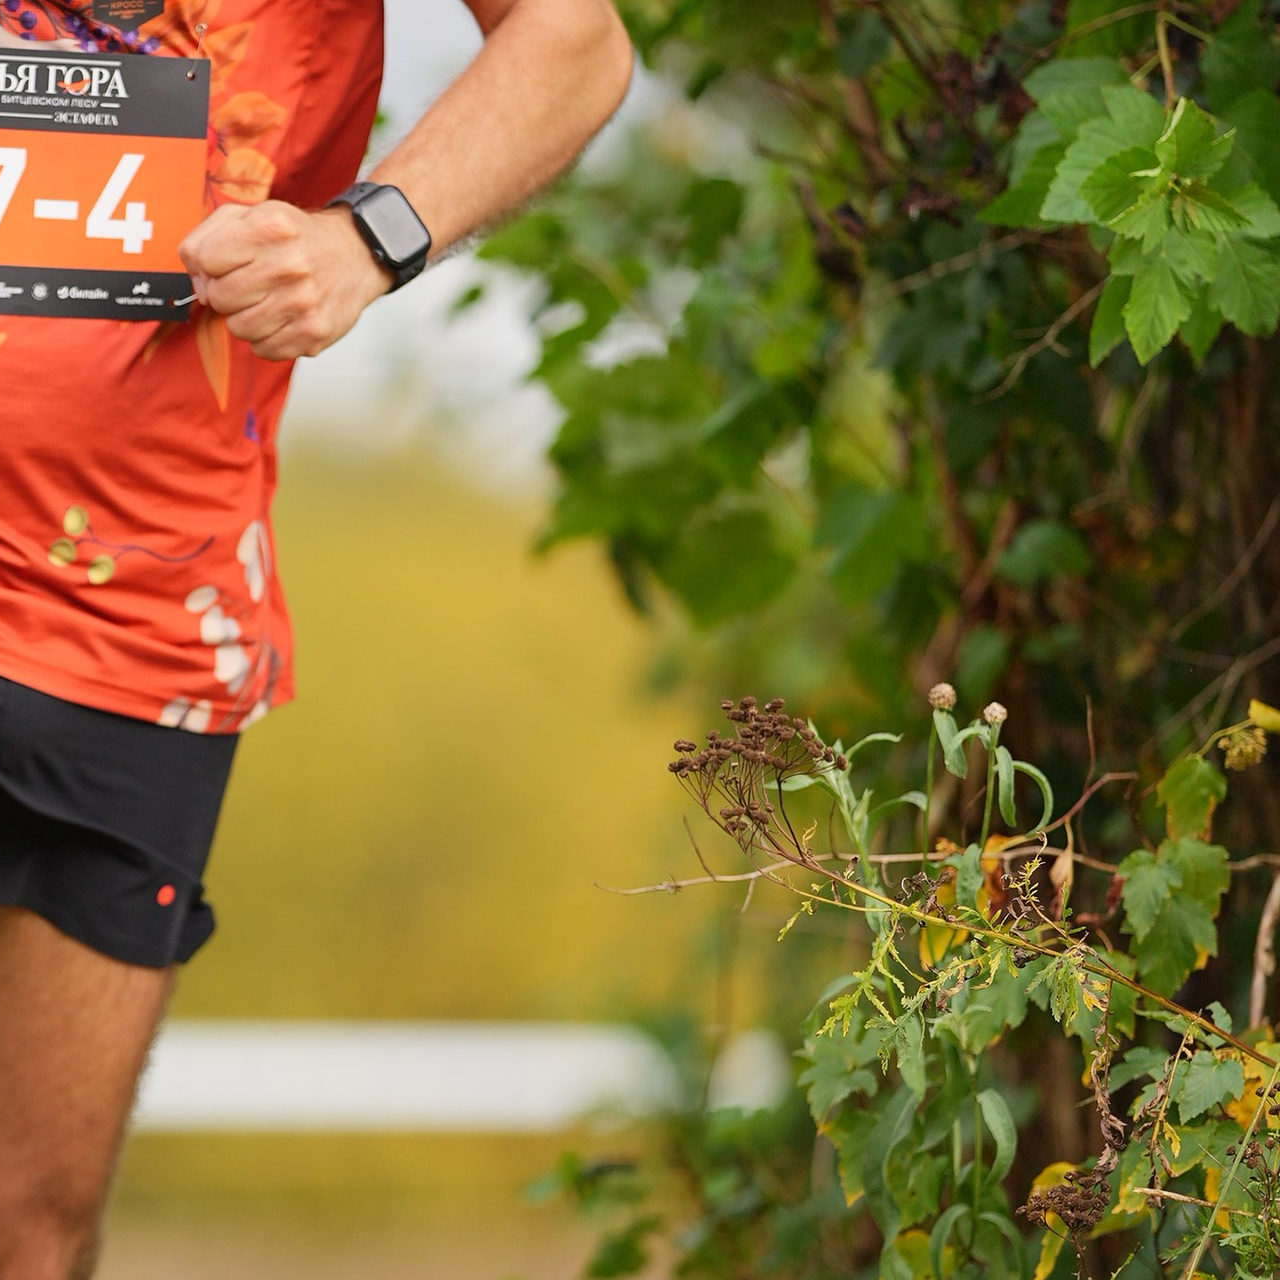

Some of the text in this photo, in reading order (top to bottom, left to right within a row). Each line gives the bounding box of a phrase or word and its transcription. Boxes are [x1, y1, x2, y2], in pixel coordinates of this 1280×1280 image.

[110, 0, 145, 9] КРОСС
[46, 64, 130, 99] ГОРА
[1, 94, 70, 107] БИТЦЕВСКОМ
[71, 99, 100, 109] ЛЕСУ
[53, 111, 120, 126] ЭСТАФЕТА
